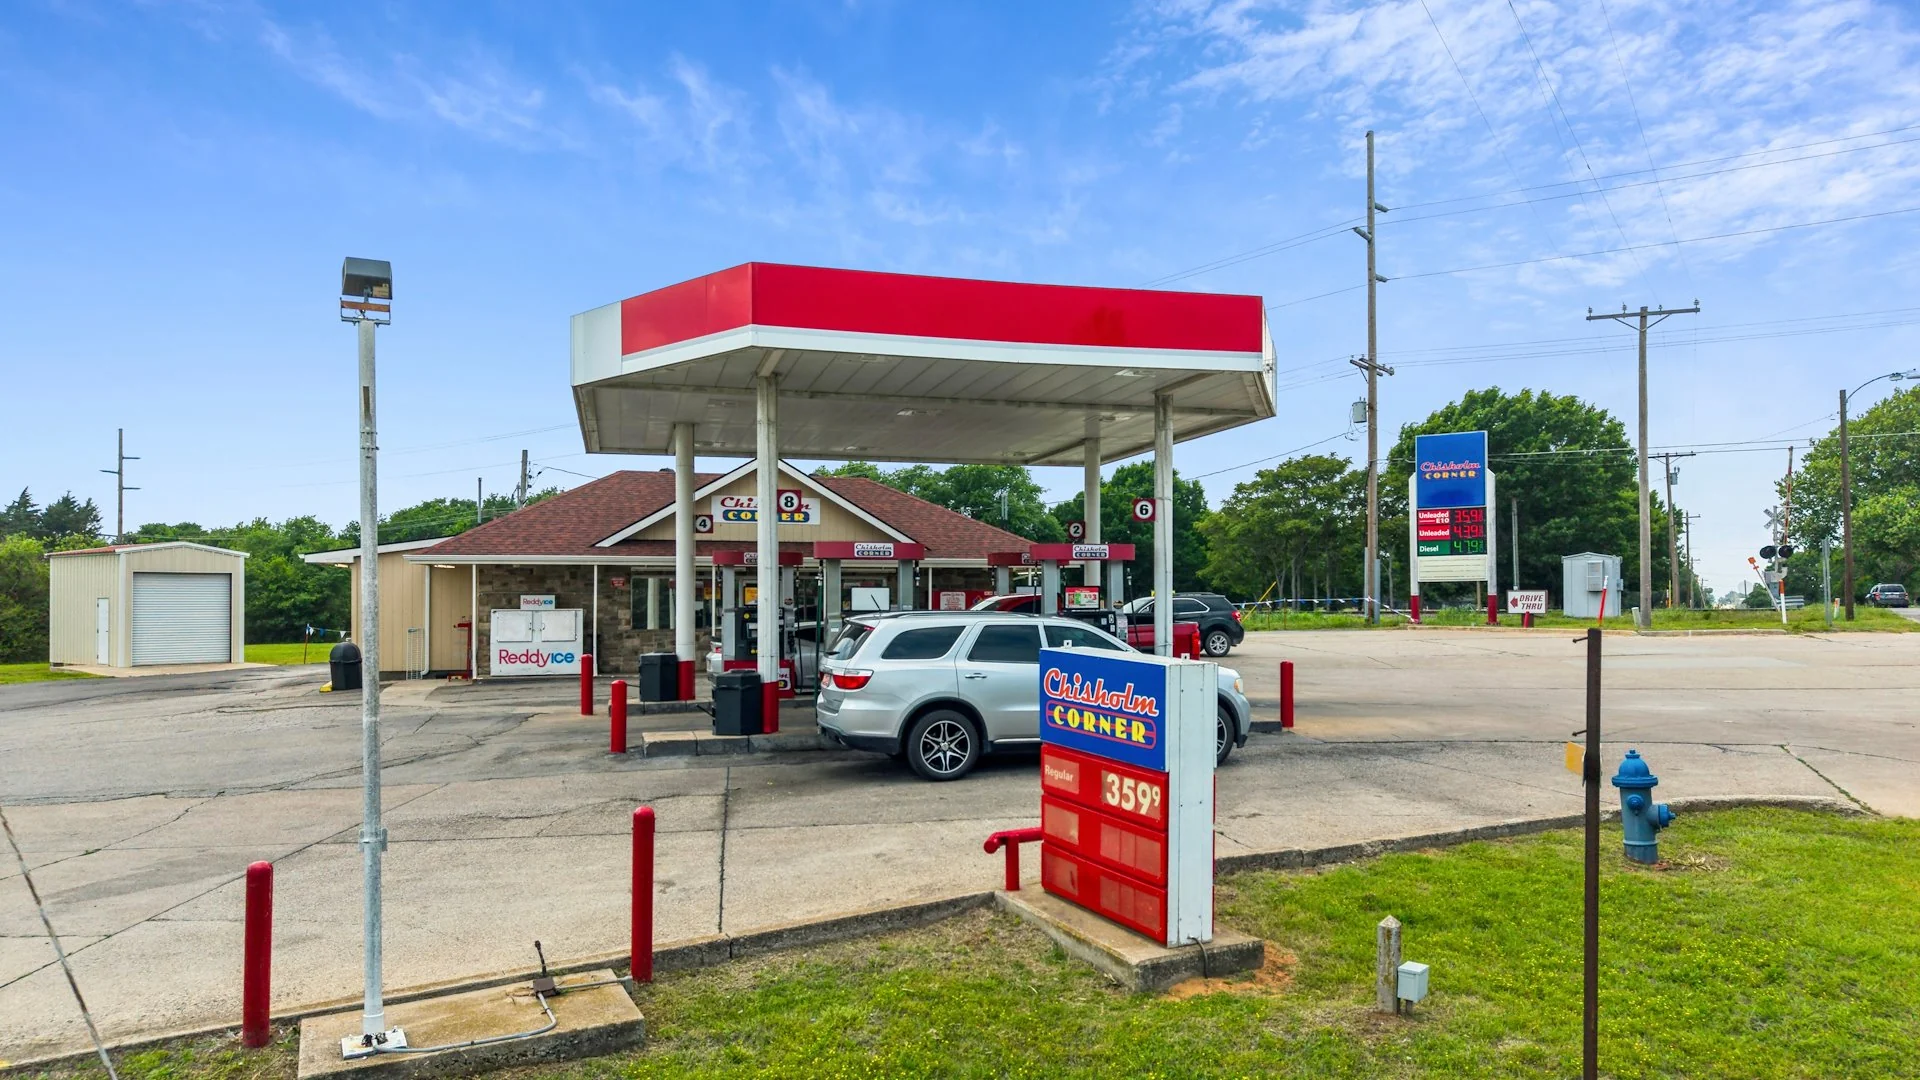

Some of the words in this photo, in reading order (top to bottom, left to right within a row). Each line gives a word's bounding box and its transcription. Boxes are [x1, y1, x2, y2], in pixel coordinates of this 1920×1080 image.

[1420, 460, 1481, 471] Chisholm
[1425, 470, 1476, 479] CORNER
[784, 495, 794, 508] 8
[727, 510, 805, 521] COER
[1139, 504, 1149, 516] 6
[1418, 511, 1449, 519] Unleaded
[698, 518, 708, 529] 4
[1072, 525, 1080, 535] 2
[1419, 529, 1450, 537] Unleaded
[855, 543, 892, 551] Chisholm
[1519, 594, 1544, 602] DRIVE
[1521, 602, 1543, 610] THRU
[1043, 667, 1159, 717] Chisholm
[1053, 705, 1147, 744] CORNER
[1044, 764, 1074, 783] Regular
